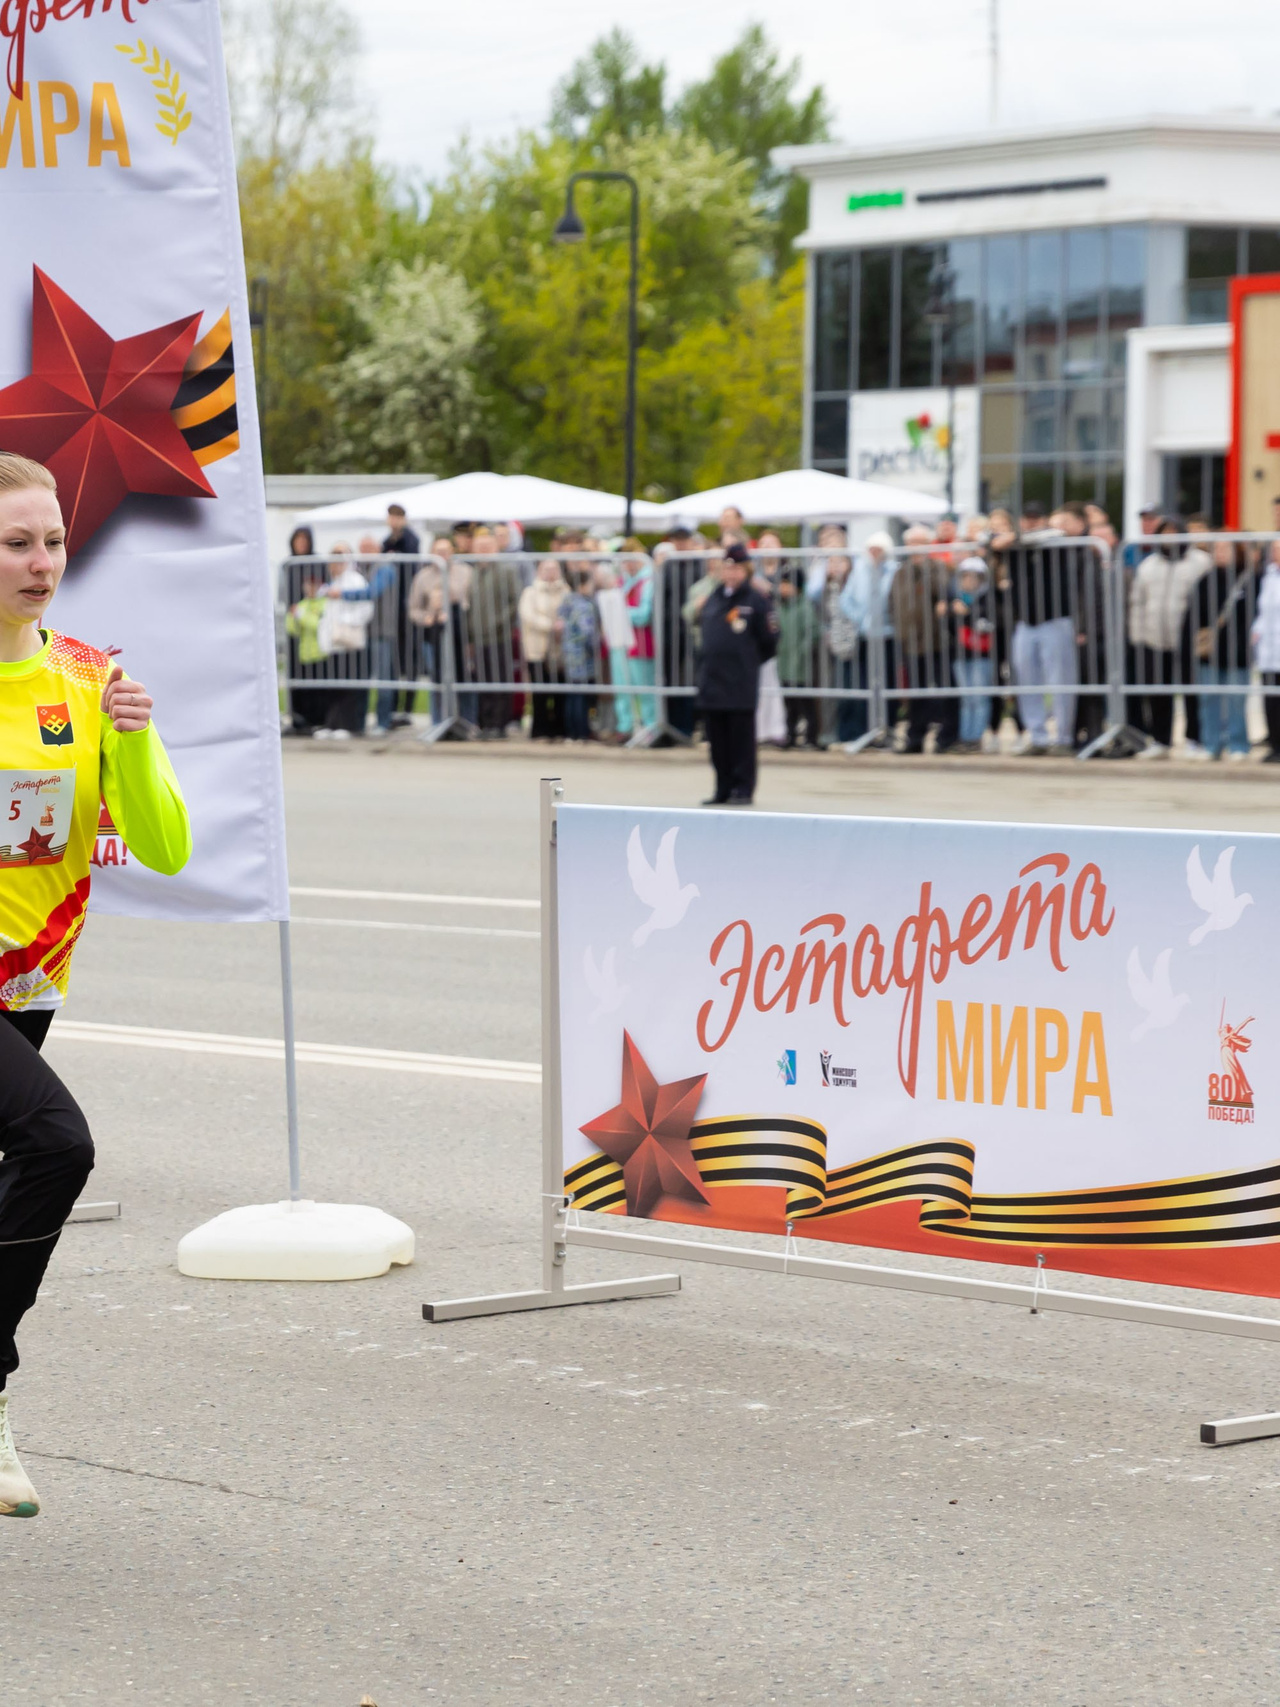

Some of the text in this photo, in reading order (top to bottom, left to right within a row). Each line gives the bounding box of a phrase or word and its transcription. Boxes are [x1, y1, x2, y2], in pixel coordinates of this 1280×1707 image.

[10, 775, 61, 796] Эстафета
[8, 799, 22, 821] 5
[696, 852, 1116, 1100] Эстафета
[935, 999, 1115, 1117] МИРА
[1208, 1072, 1233, 1102] 80
[1208, 1105, 1255, 1125] ПОБЕДА!
